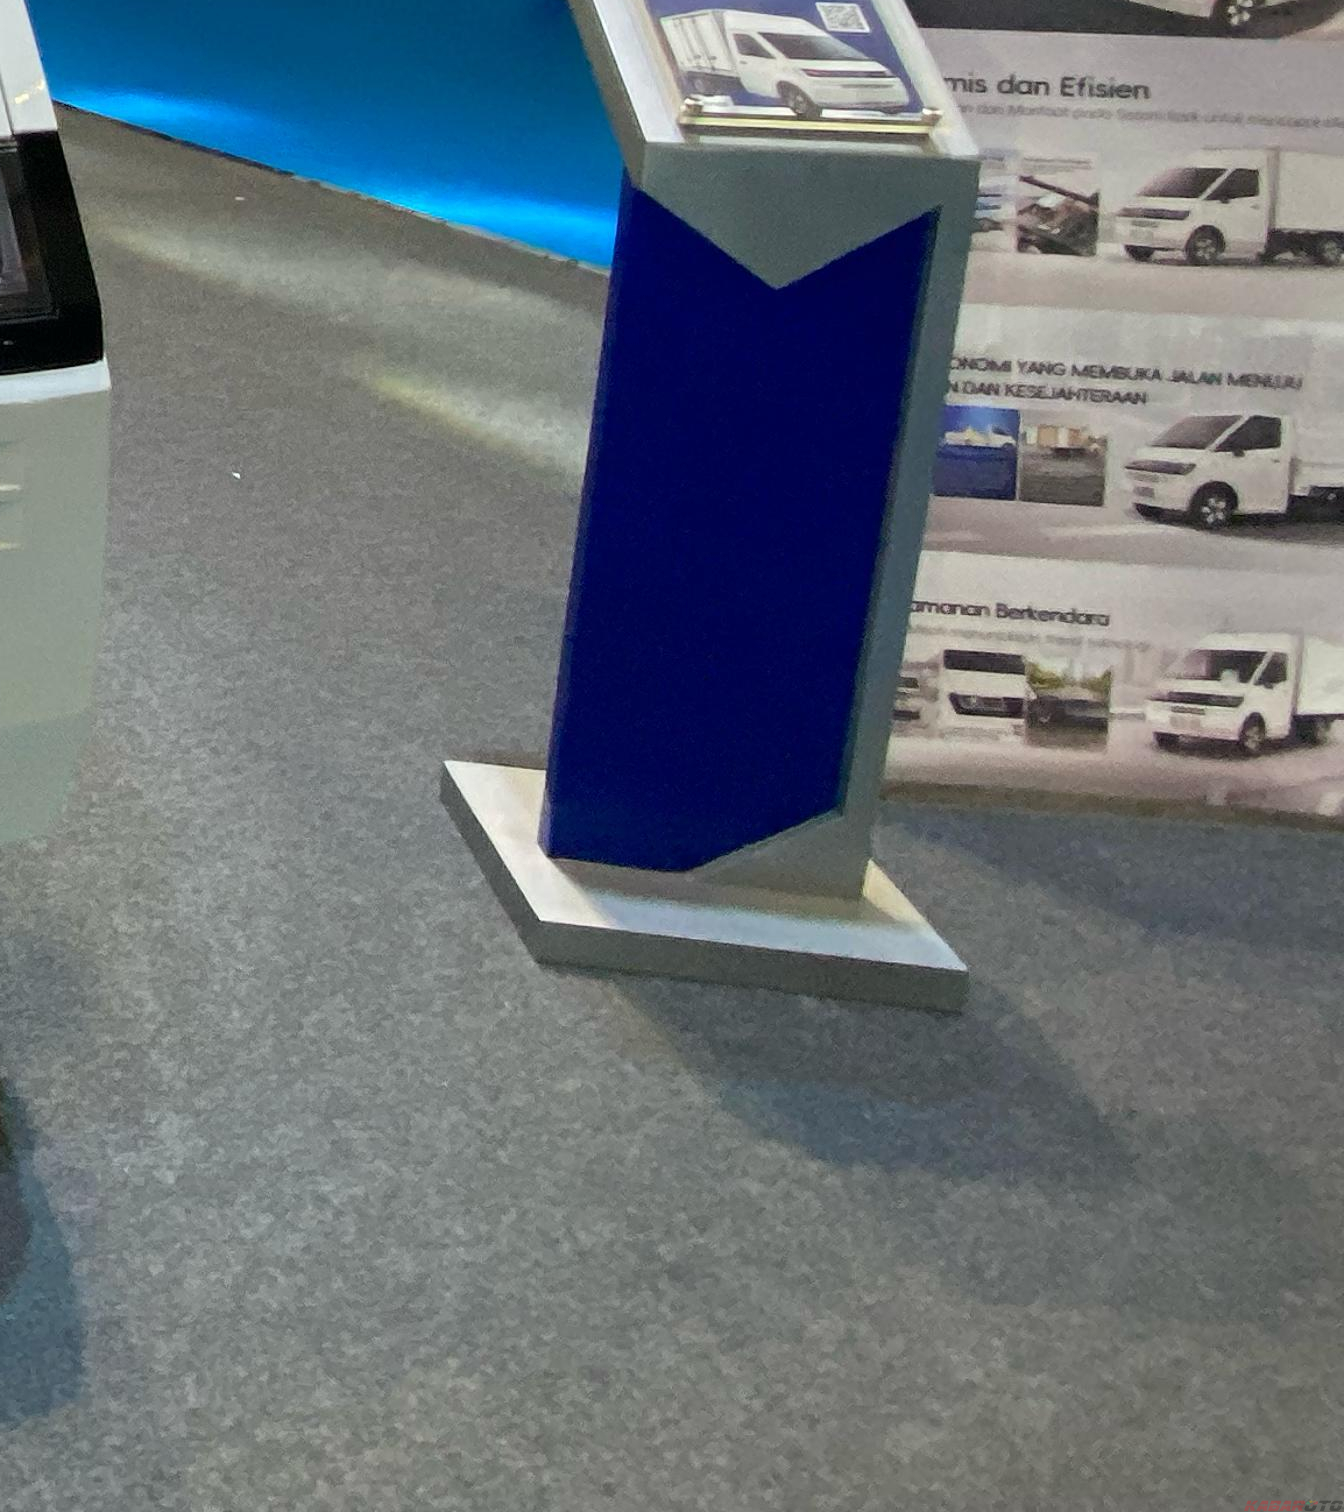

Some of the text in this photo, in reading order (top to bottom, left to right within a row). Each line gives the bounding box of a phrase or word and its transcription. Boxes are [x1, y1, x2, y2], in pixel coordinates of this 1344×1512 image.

[996, 75, 1050, 96] dan
[1060, 76, 1152, 100] Efisien
[1017, 360, 1067, 376] YANG
